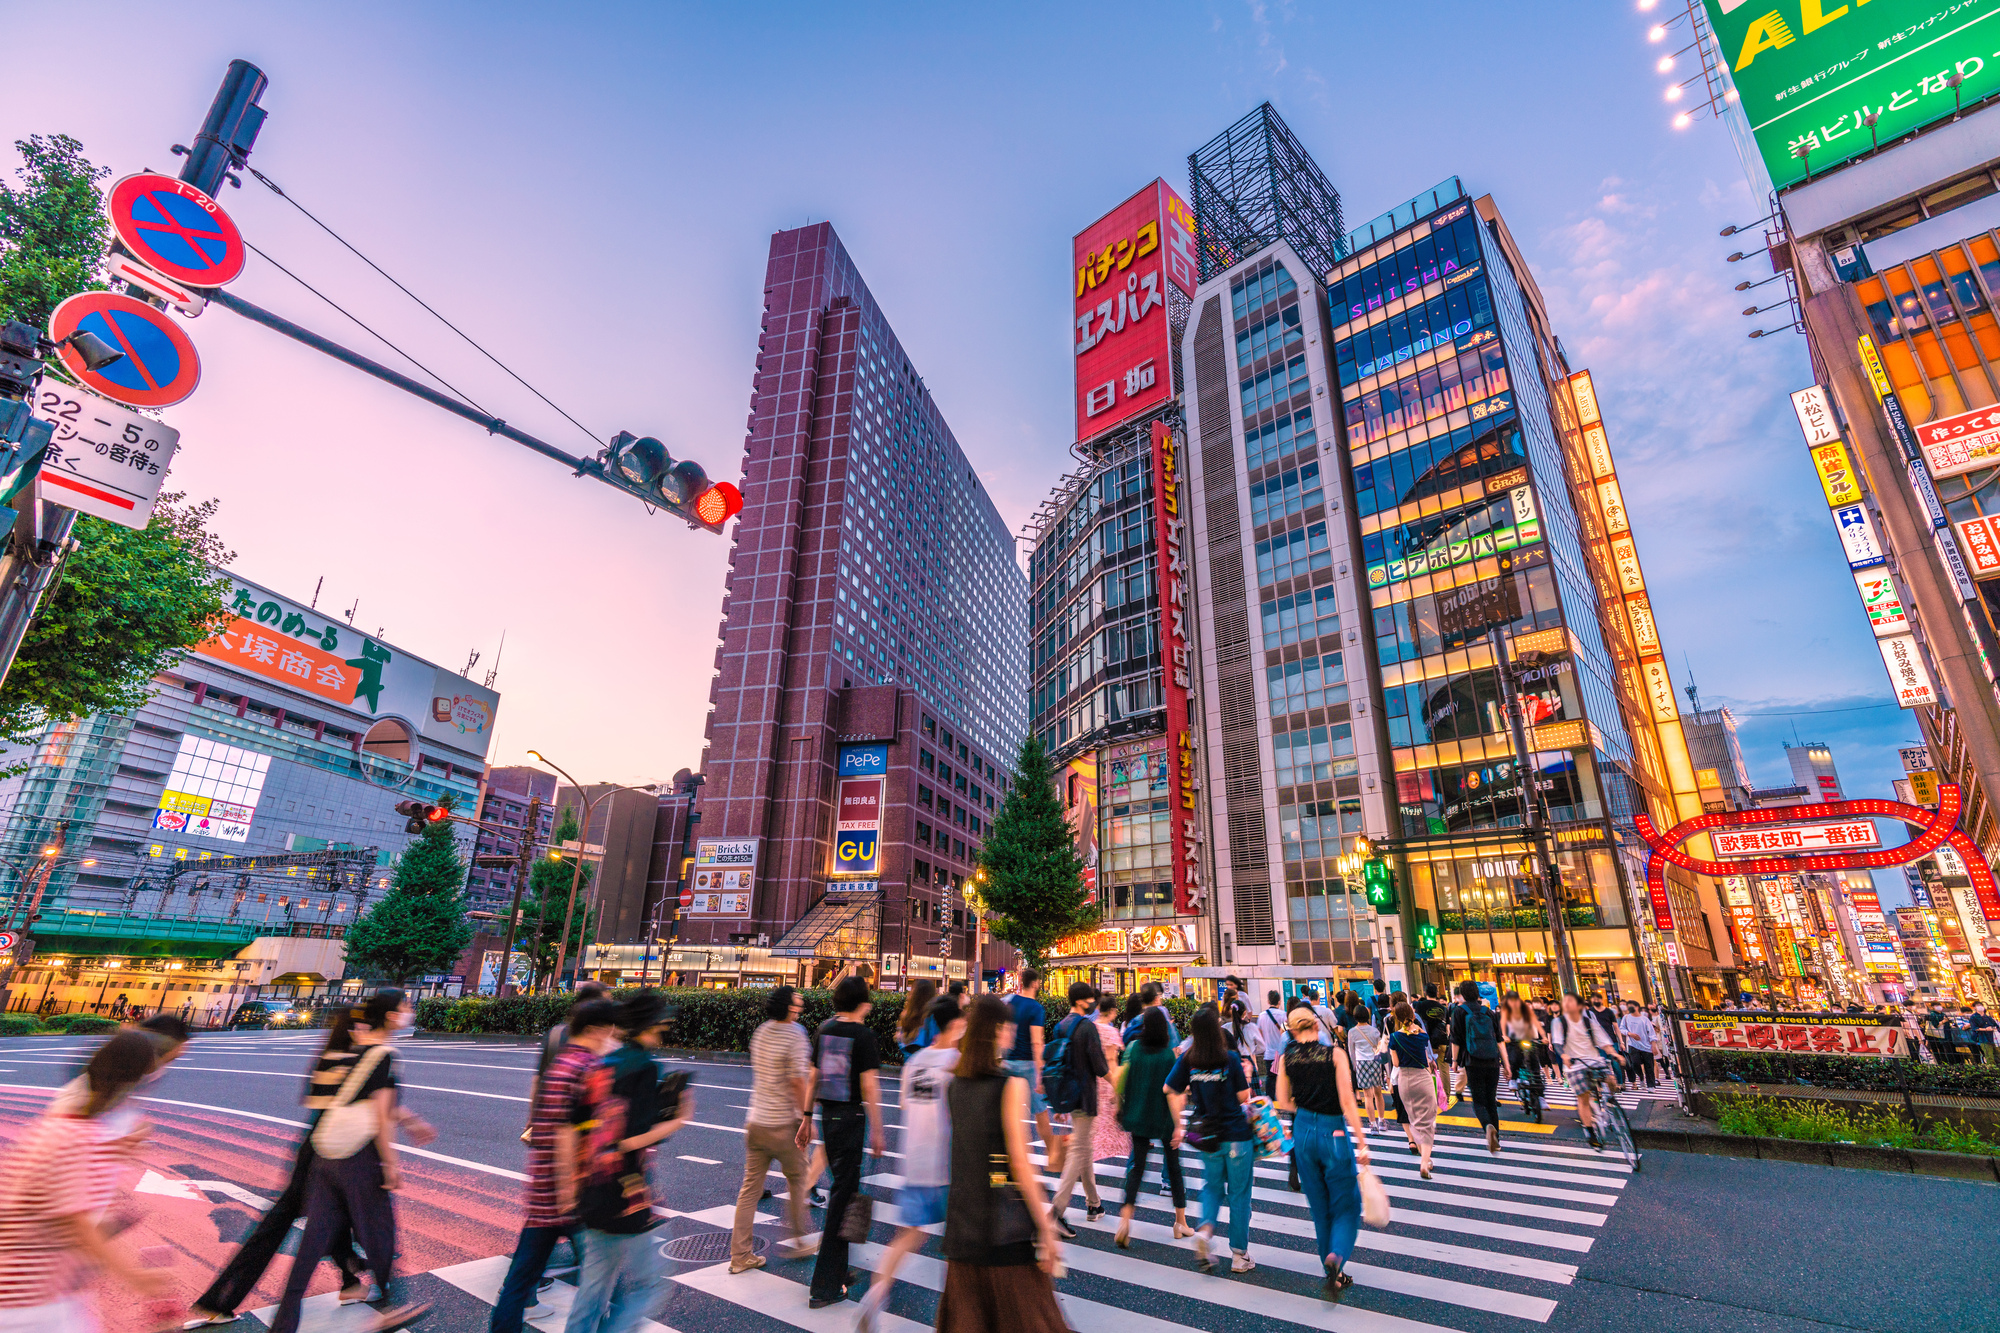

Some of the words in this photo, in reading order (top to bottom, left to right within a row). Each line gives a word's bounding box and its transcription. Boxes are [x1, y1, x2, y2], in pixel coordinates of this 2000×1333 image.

[1775, 48, 1869, 102] 新生銀行グループ
[1076, 219, 1159, 298] パチンコ
[1841, 257, 1853, 265] 8F
[1352, 259, 1459, 319] SHISHA
[1076, 270, 1163, 356] エスパス
[1360, 320, 1471, 378] CASINO
[1086, 357, 1155, 418] 日拓
[1578, 395, 1592, 417] ABYSS
[1801, 391, 1830, 442] 小松ビル
[1885, 396, 1899, 413] BUZZ
[1892, 410, 1905, 430] STAND
[1590, 431, 1602, 455] CASINO
[1596, 454, 1607, 474] POKER
[1934, 454, 1969, 470] 名物
[1161, 434, 1177, 514] パチンコ
[1488, 474, 1526, 492] GROVE
[1818, 446, 1853, 495] 麻雀ブル
[1515, 488, 1531, 519] ダーツ
[1836, 492, 1852, 503] 6F
[1848, 527, 1862, 555] クリニック
[1858, 525, 1873, 558] メンズライフ
[1967, 523, 1998, 567] お好み焼
[1388, 534, 1515, 580] ビアポンバー
[1512, 549, 1545, 566] すずや
[1944, 540, 1969, 585] 歌舞伎町名物
[1167, 517, 1186, 642] エスパス
[1622, 565, 1640, 586] 魚金
[231, 588, 338, 651] たのめーる
[1872, 602, 1896, 611] たばこ
[1878, 615, 1898, 624] ATM
[1631, 604, 1646, 642] ビアポンバー
[1891, 640, 1917, 686] お好み焼き
[1653, 677, 1672, 717] すずや
[1901, 686, 1930, 698] 本陣
[1904, 696, 1931, 705] HONJIN
[845, 753, 880, 767] PePe
[1901, 748, 1927, 760] ポケット
[1910, 758, 1926, 768] ビル
[1178, 730, 1195, 810] パチンコ
[844, 795, 876, 806] 無印良品
[718, 844, 740, 853] Brick
[743, 844, 753, 853] St.
[1558, 829, 1604, 842] DOUTOR
[1720, 824, 1871, 852] 歌舞伎町一番街
[838, 840, 875, 861] GU
[1184, 818, 1201, 910] エスパス
[830, 881, 875, 891] 西武新宿駅
[1733, 907, 1754, 916] 焼肉
[1963, 889, 1987, 934] お好み焼き
[1491, 951, 1545, 965] DOUTOR
[1693, 1013, 1739, 1023] Smorking
[1756, 1015, 1773, 1023] the
[1775, 1016, 1807, 1025] street
[1809, 1016, 1819, 1025] is
[1822, 1016, 1882, 1027] prohibited.
